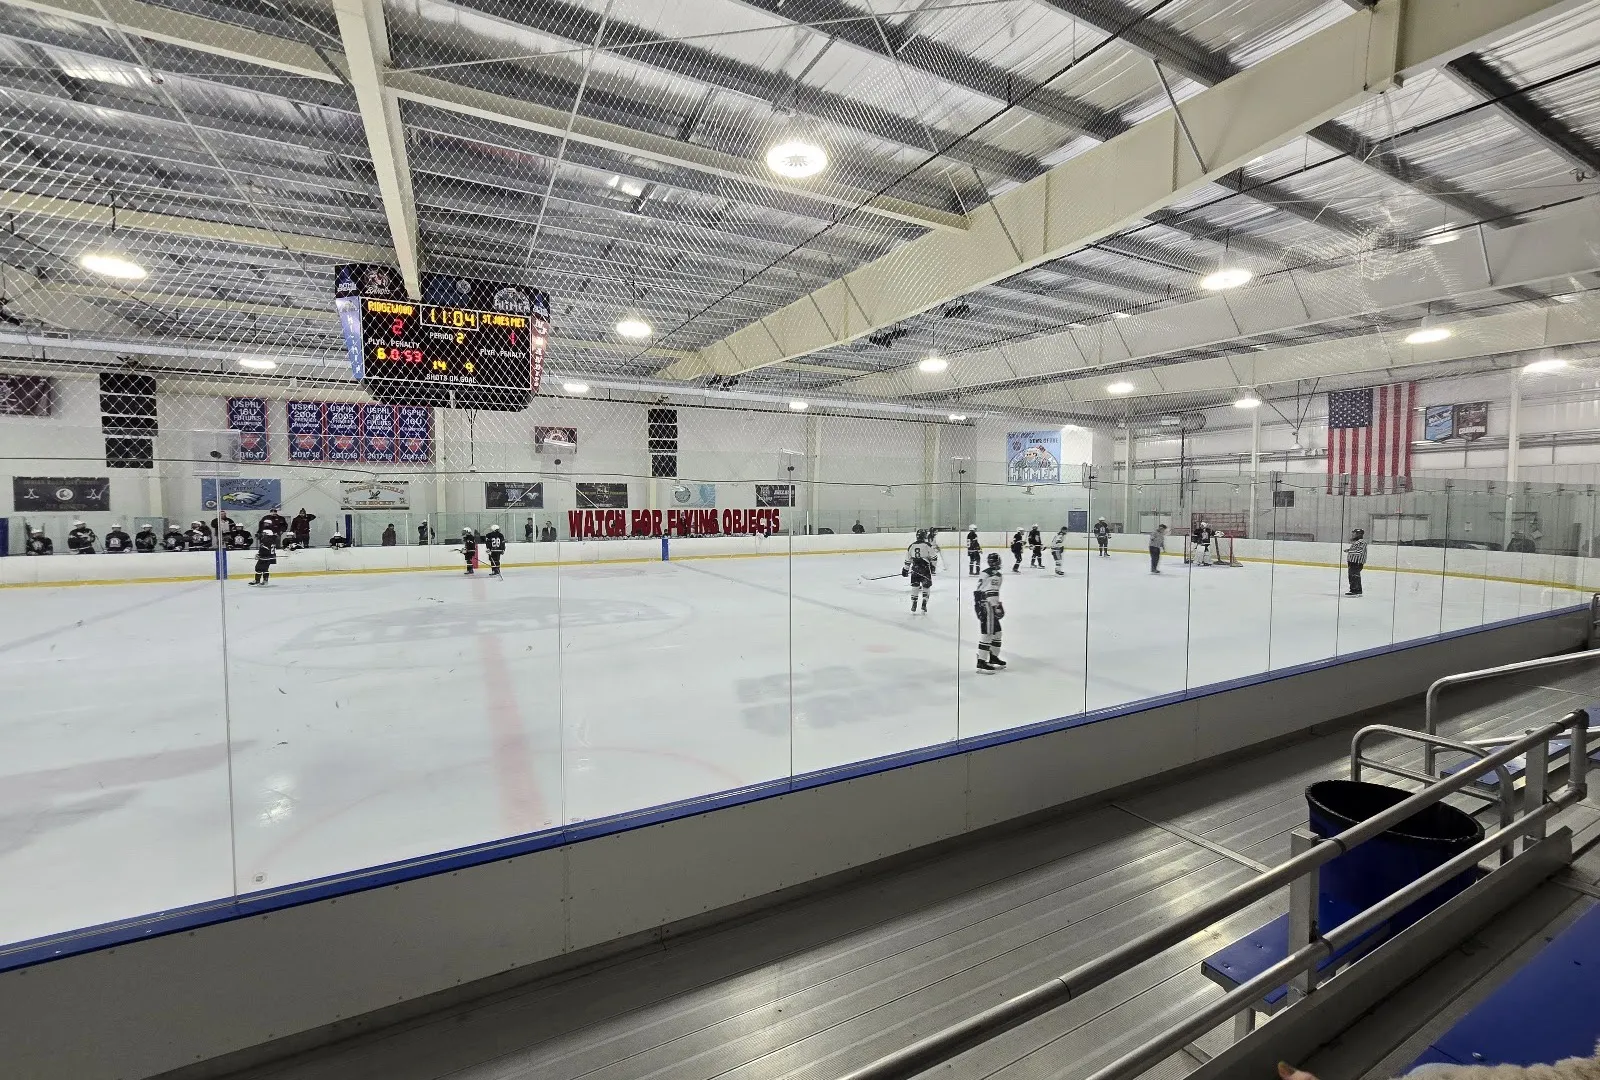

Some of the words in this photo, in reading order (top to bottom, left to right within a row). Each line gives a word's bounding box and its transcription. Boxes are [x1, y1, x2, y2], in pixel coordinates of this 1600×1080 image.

[368, 301, 413, 315] RIDGEWOOD
[430, 308, 475, 327] 11:04
[392, 319, 403, 335] 2
[430, 332, 453, 341] PERIOD
[456, 332, 464, 344] 2
[368, 338, 385, 346] PLYR
[391, 339, 420, 349] PENALTY
[390, 348, 422, 362] 0:53
[500, 350, 526, 359] PENALTY
[427, 373, 447, 382] SHOTS
[232, 400, 260, 408] USPHL
[568, 510, 626, 538] WATCH
[632, 510, 662, 537] FOR
[667, 509, 720, 537] FLYING
[722, 508, 780, 535] OBJECTS
